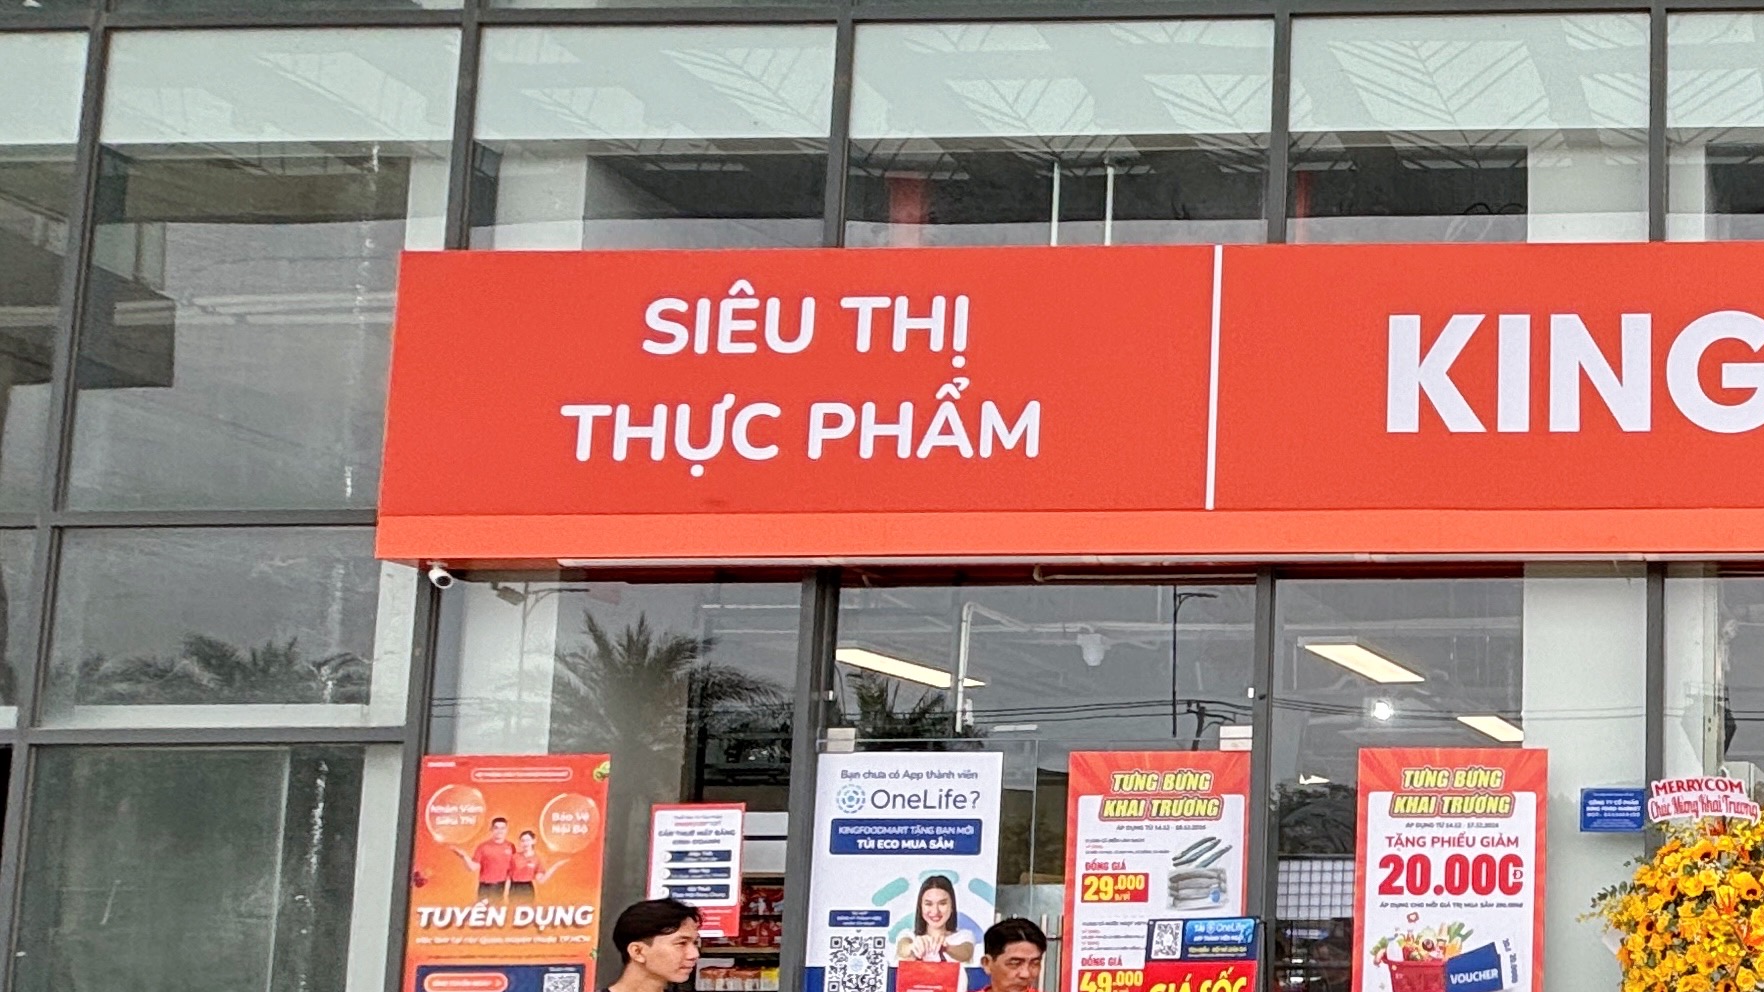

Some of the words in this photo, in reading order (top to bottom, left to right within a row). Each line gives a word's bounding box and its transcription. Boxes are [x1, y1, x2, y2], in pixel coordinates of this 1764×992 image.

[643, 279, 815, 356] SIÊU
[841, 294, 969, 369] THỊ
[561, 393, 781, 477] THỰC
[808, 378, 1041, 461] PHẨM
[841, 770, 860, 781] Bạn
[888, 770, 900, 779] có
[902, 770, 923, 780] App
[1162, 770, 1212, 792] BỪNG
[1453, 767, 1503, 788] BỪNG
[1654, 778, 1744, 796] MERRYCOM
[871, 788, 980, 809] OneLife?
[1103, 799, 1145, 817] KHAI
[1394, 796, 1435, 815] KHAI
[877, 840, 899, 849] ECO
[901, 840, 927, 849] MUA
[1385, 833, 1426, 851] TẶNG
[1431, 830, 1476, 848] PHIẾU
[1480, 832, 1519, 848] GIẢM
[1112, 858, 1126, 871] GIÁ
[417, 899, 507, 928] TUYỂN
[513, 905, 594, 931] DỤNG
[1108, 954, 1122, 966] GIÁ
[1450, 968, 1498, 985] VOUCHER
